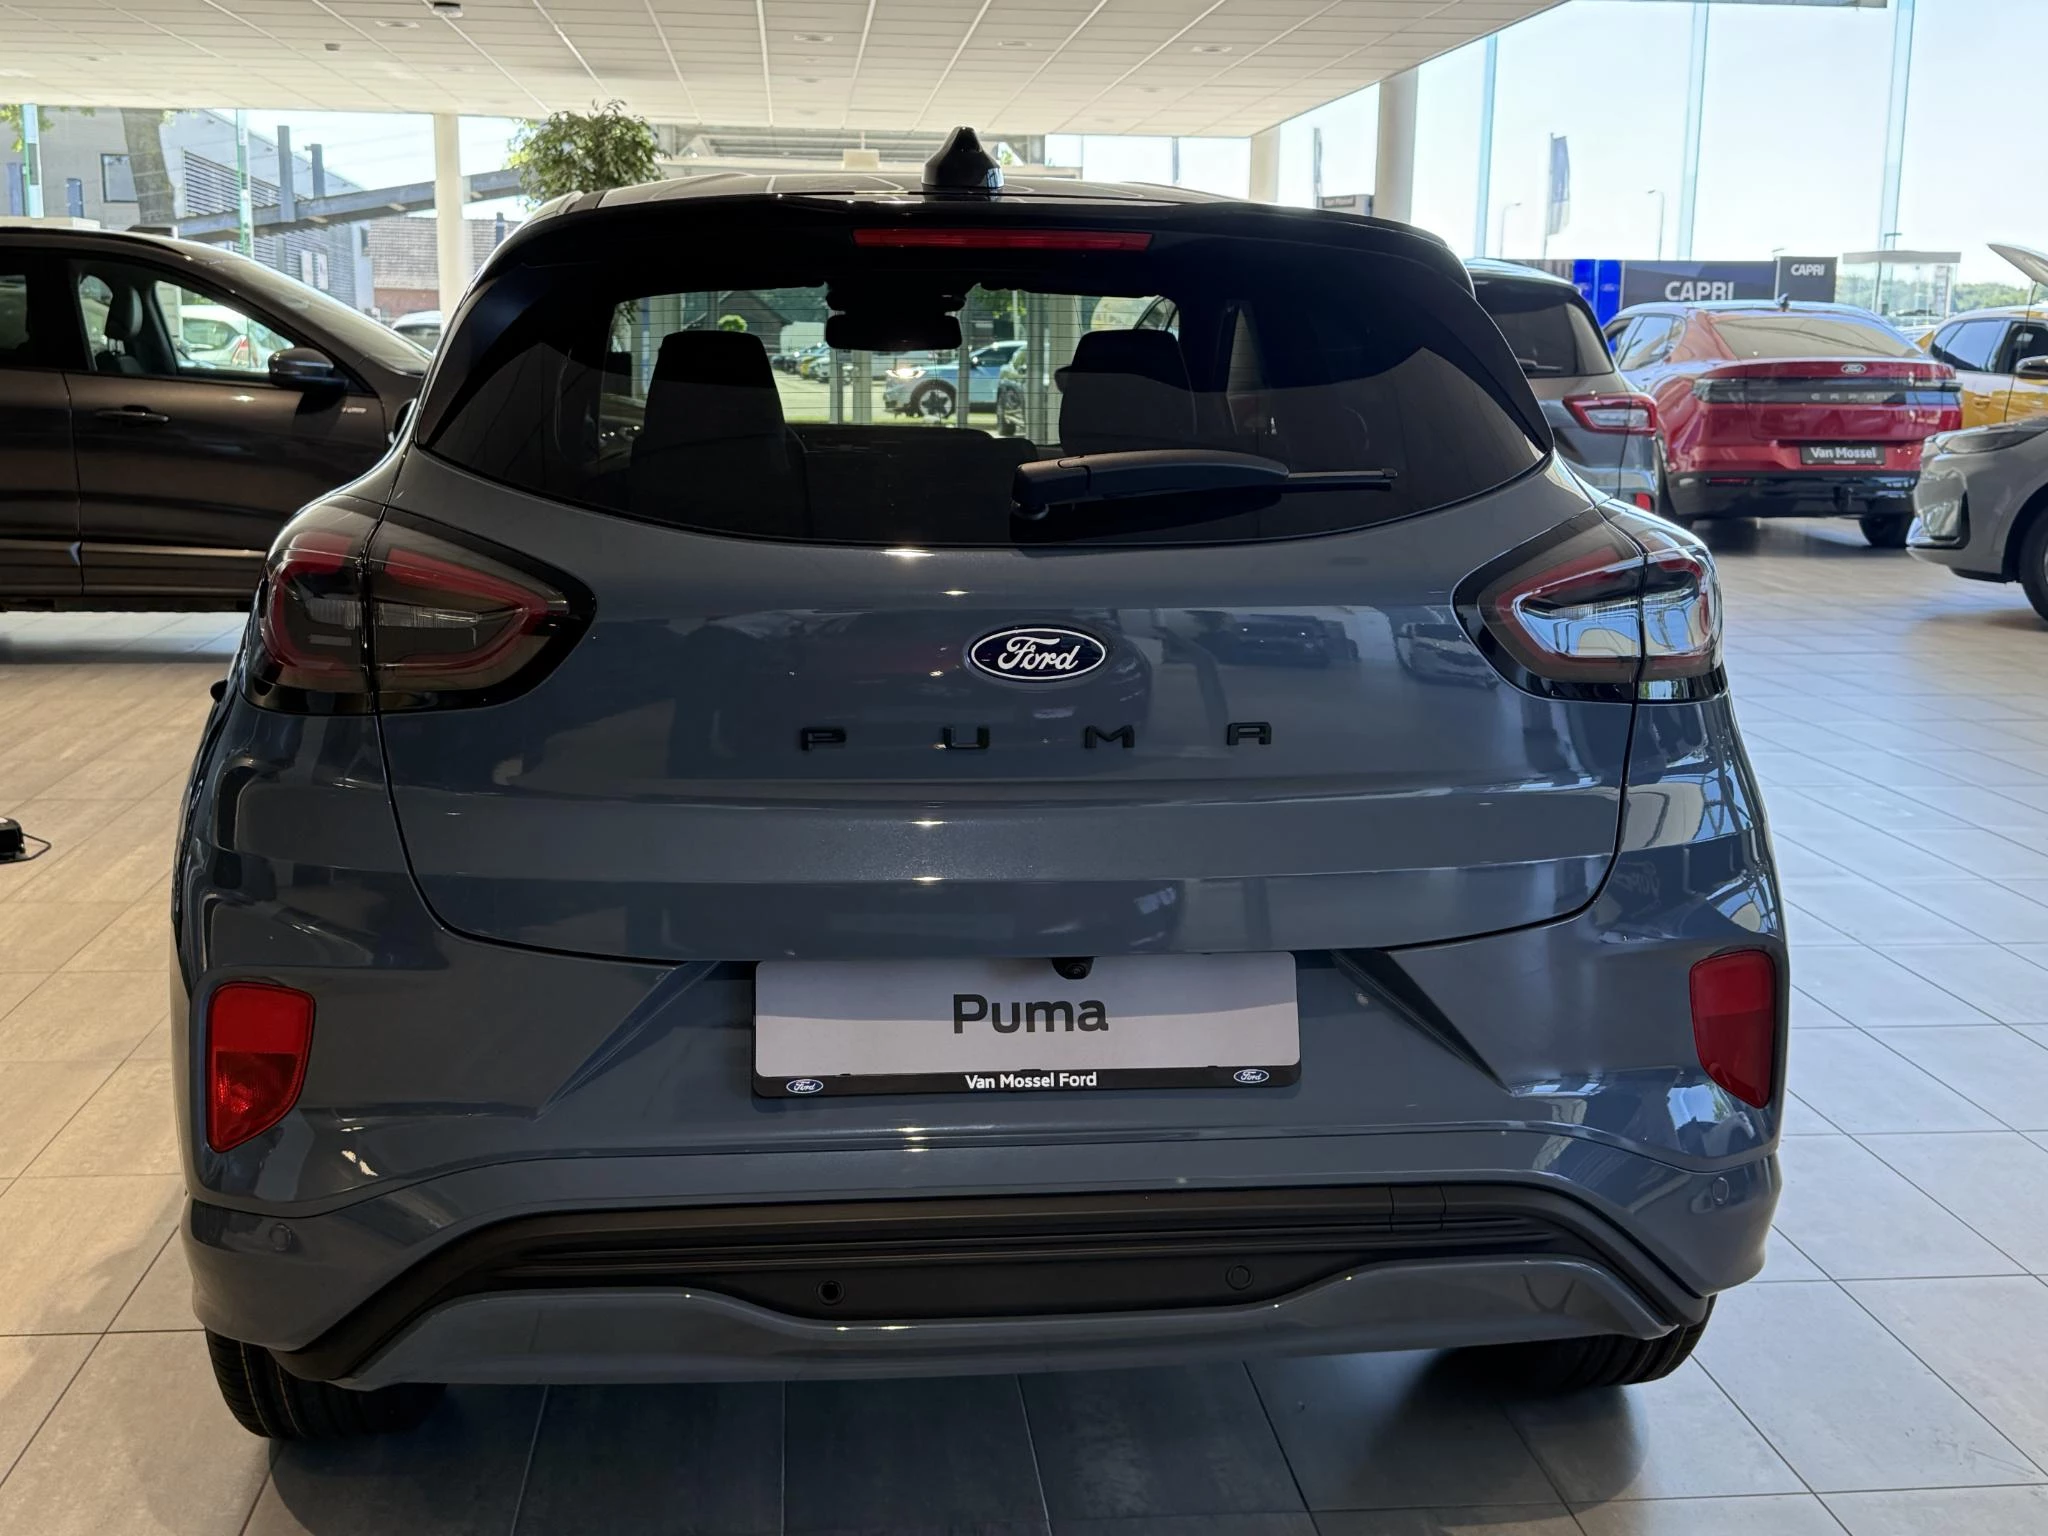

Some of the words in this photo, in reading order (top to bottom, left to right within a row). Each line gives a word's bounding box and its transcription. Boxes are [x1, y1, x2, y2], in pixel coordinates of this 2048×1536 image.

[1791, 263, 1825, 276] CAPRI
[1664, 281, 1735, 301] CAPRI
[1810, 446, 1834, 458] Van
[1835, 446, 1877, 458] Mossel
[997, 636, 1081, 670] Ford
[800, 721, 1272, 751] PUMA
[953, 993, 1109, 1034] Puma
[965, 1074, 996, 1089] Van
[999, 1072, 1055, 1088] Mossel
[1059, 1071, 1097, 1087] Ford
